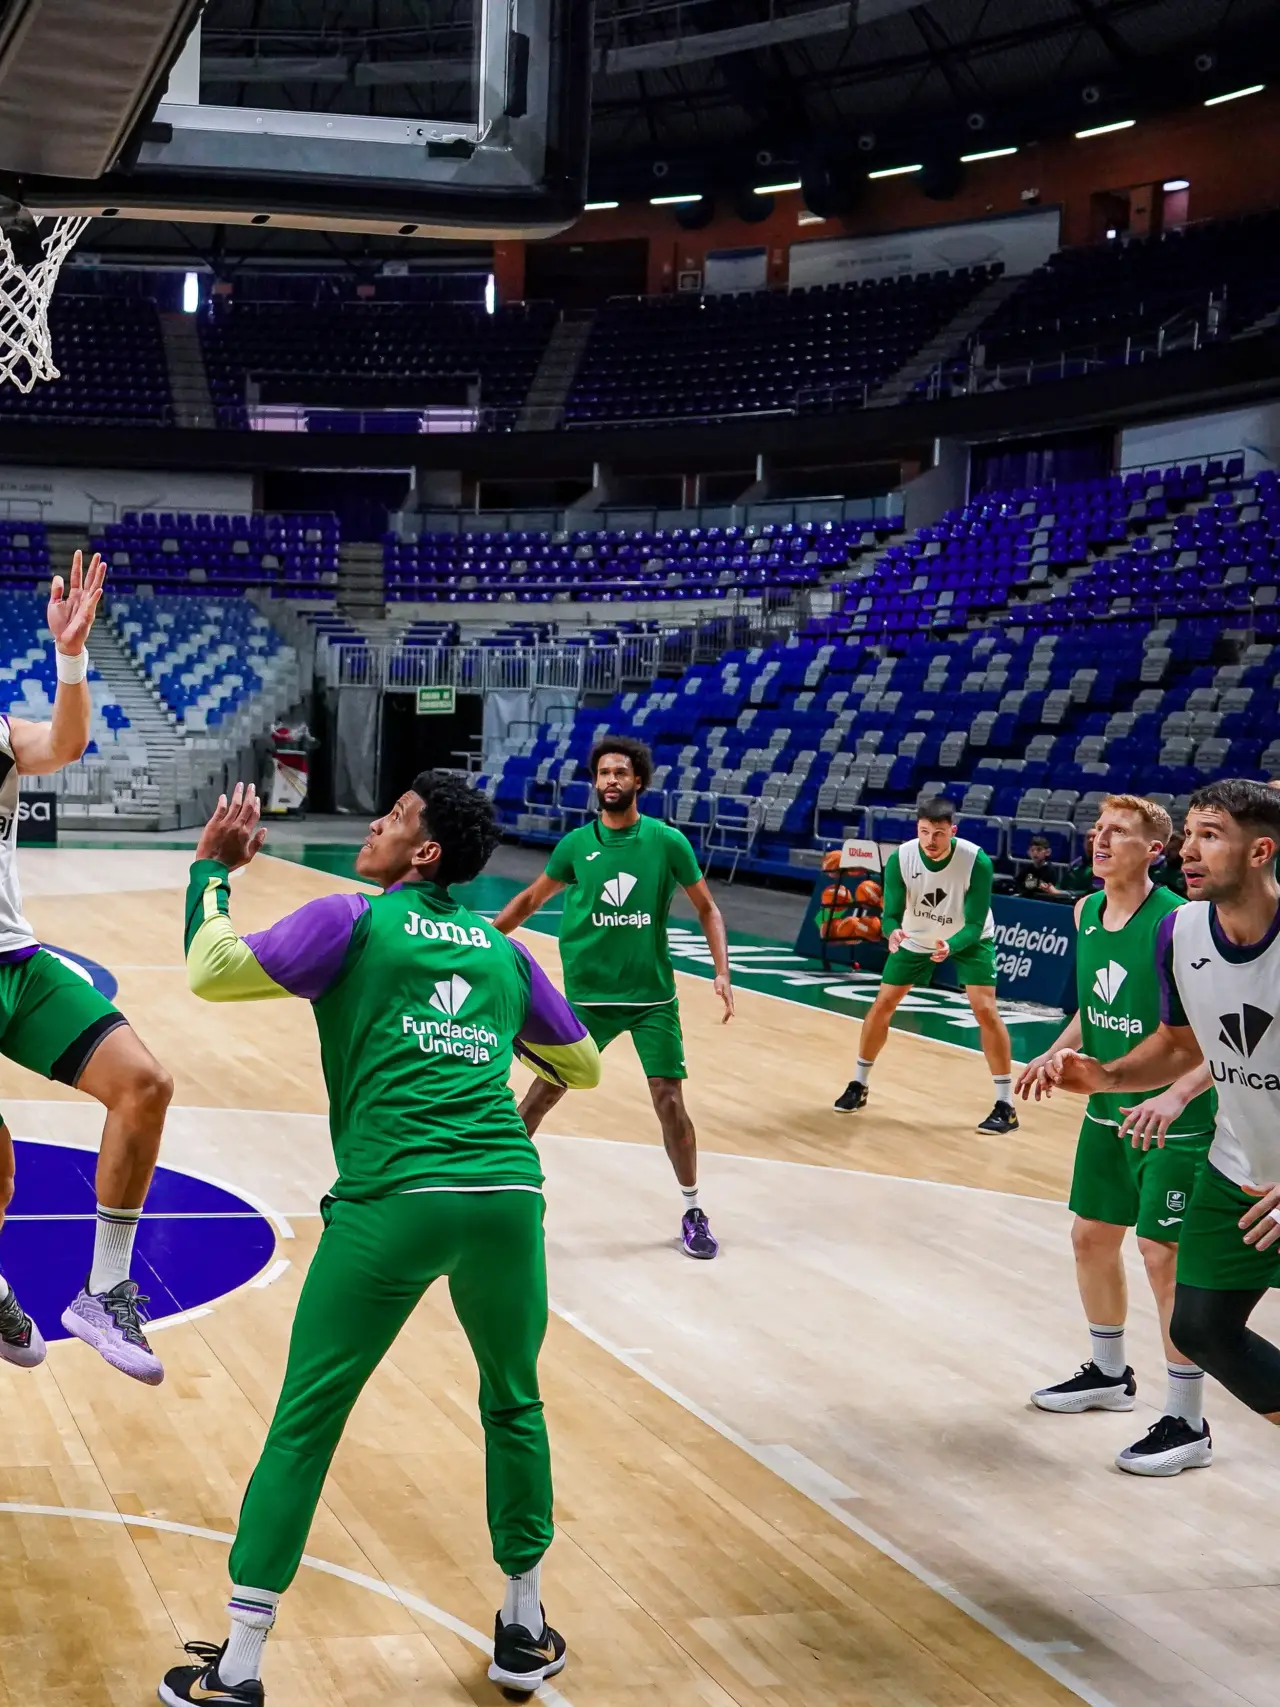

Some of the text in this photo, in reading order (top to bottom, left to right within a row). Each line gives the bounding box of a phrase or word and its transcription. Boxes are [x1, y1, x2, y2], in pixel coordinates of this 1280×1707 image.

[848, 847, 873, 859] Wilson
[404, 911, 492, 949] Joma
[591, 910, 651, 929] Unicaja
[913, 907, 953, 926] Unicaja
[992, 922, 1069, 956] ndación
[402, 1015, 499, 1048] Fundación
[1087, 1006, 1143, 1038] Unicaja
[418, 1035, 491, 1065] Unicaja
[1209, 1059, 1280, 1091] Unica
